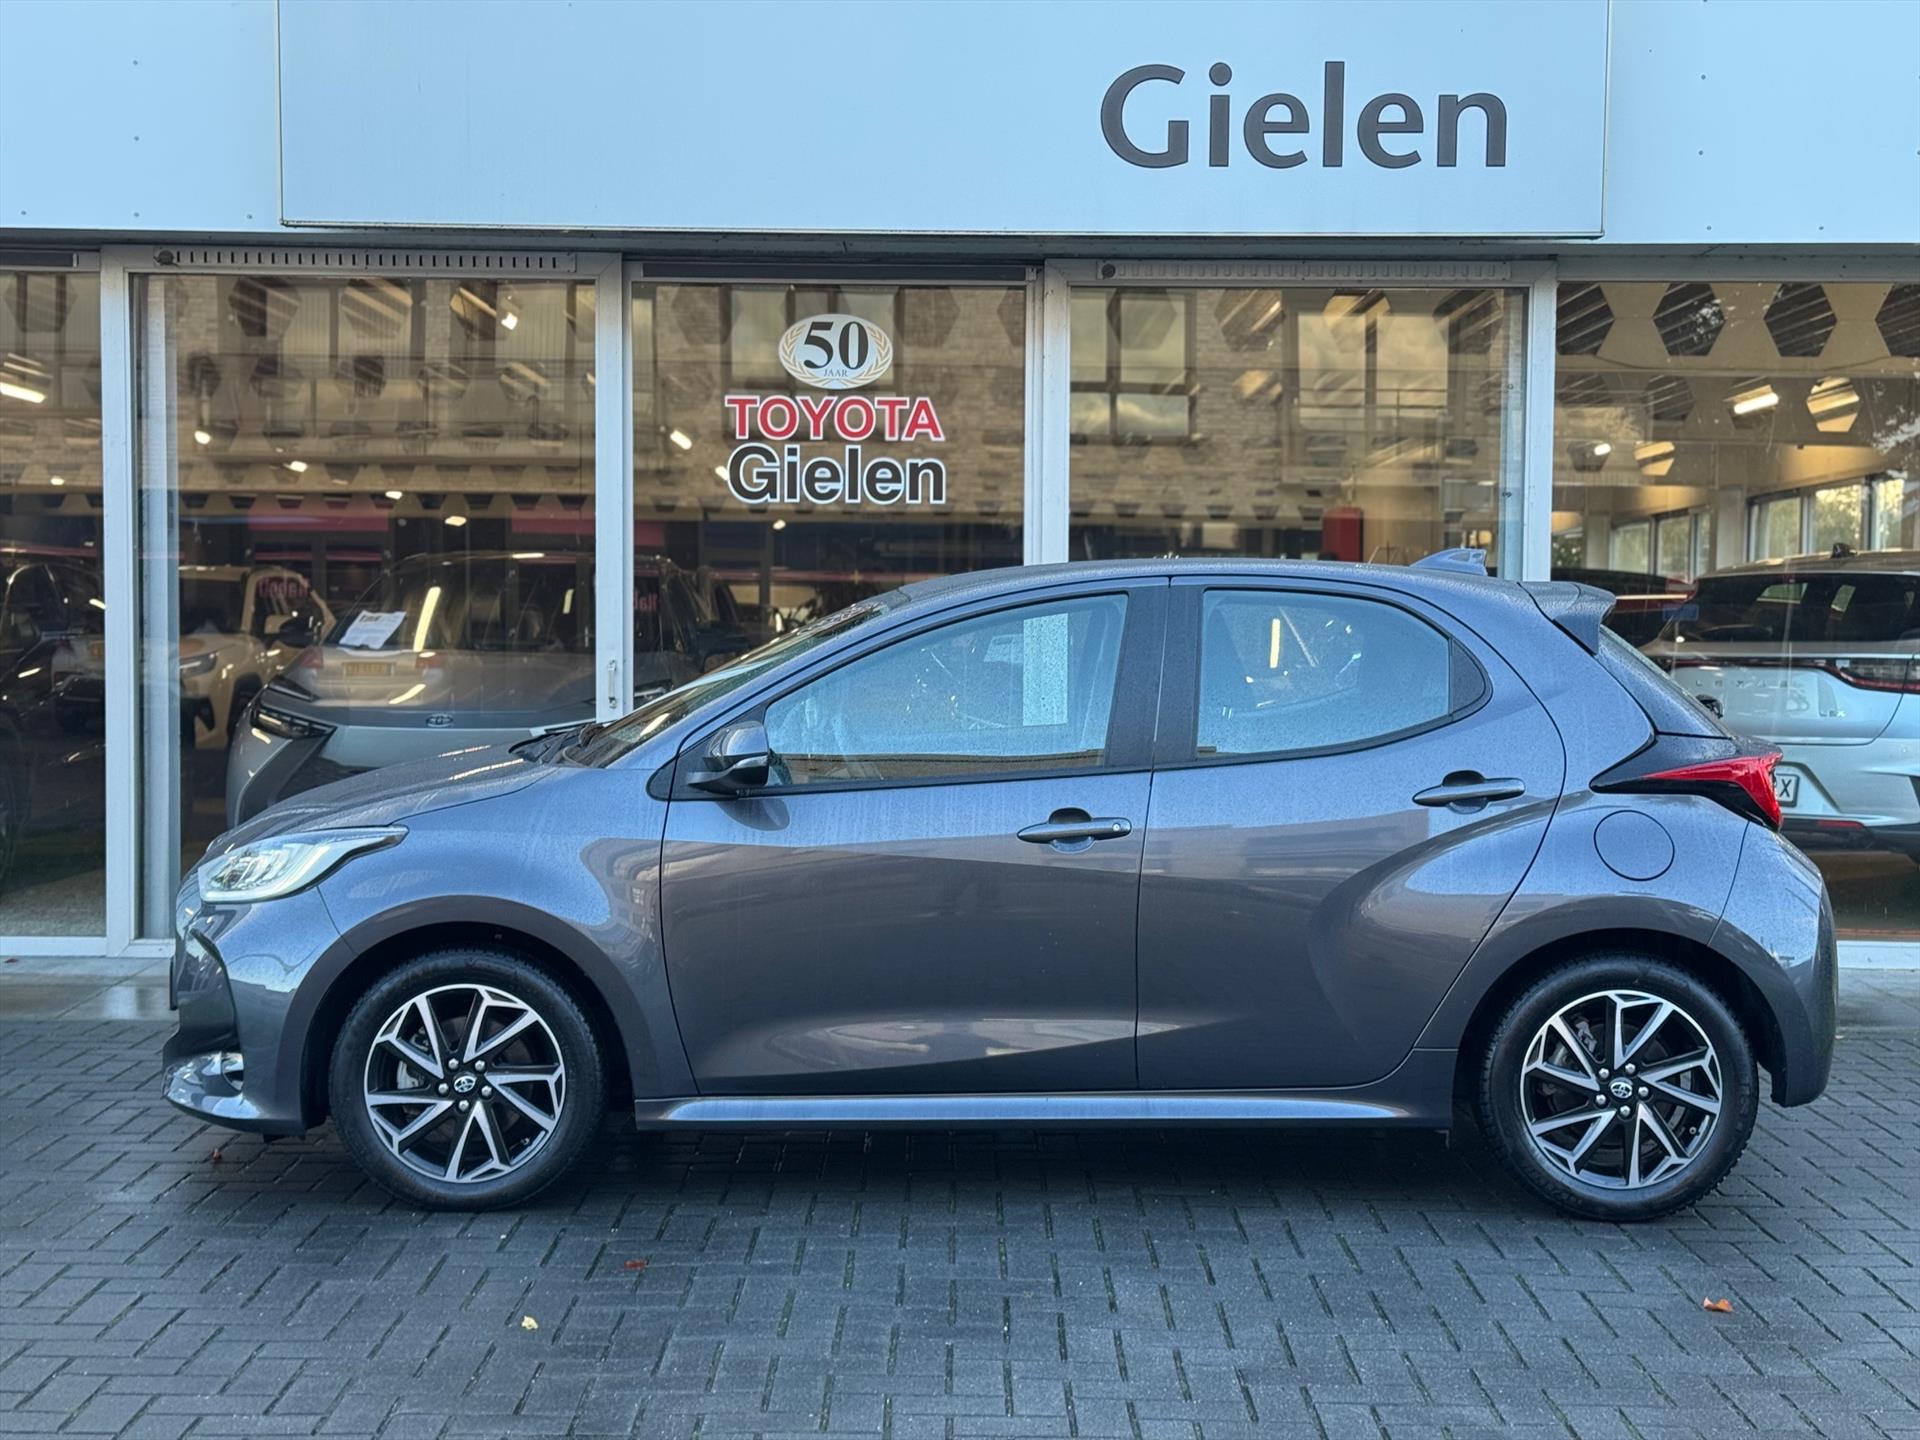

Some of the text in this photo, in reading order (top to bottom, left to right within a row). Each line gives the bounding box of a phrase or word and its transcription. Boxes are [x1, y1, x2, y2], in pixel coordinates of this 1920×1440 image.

[1100, 61, 1508, 169] Gielen
[803, 320, 869, 369] 50
[823, 369, 848, 378] JAAR
[725, 396, 945, 441] TOYOTA
[727, 442, 946, 504] Gielen
